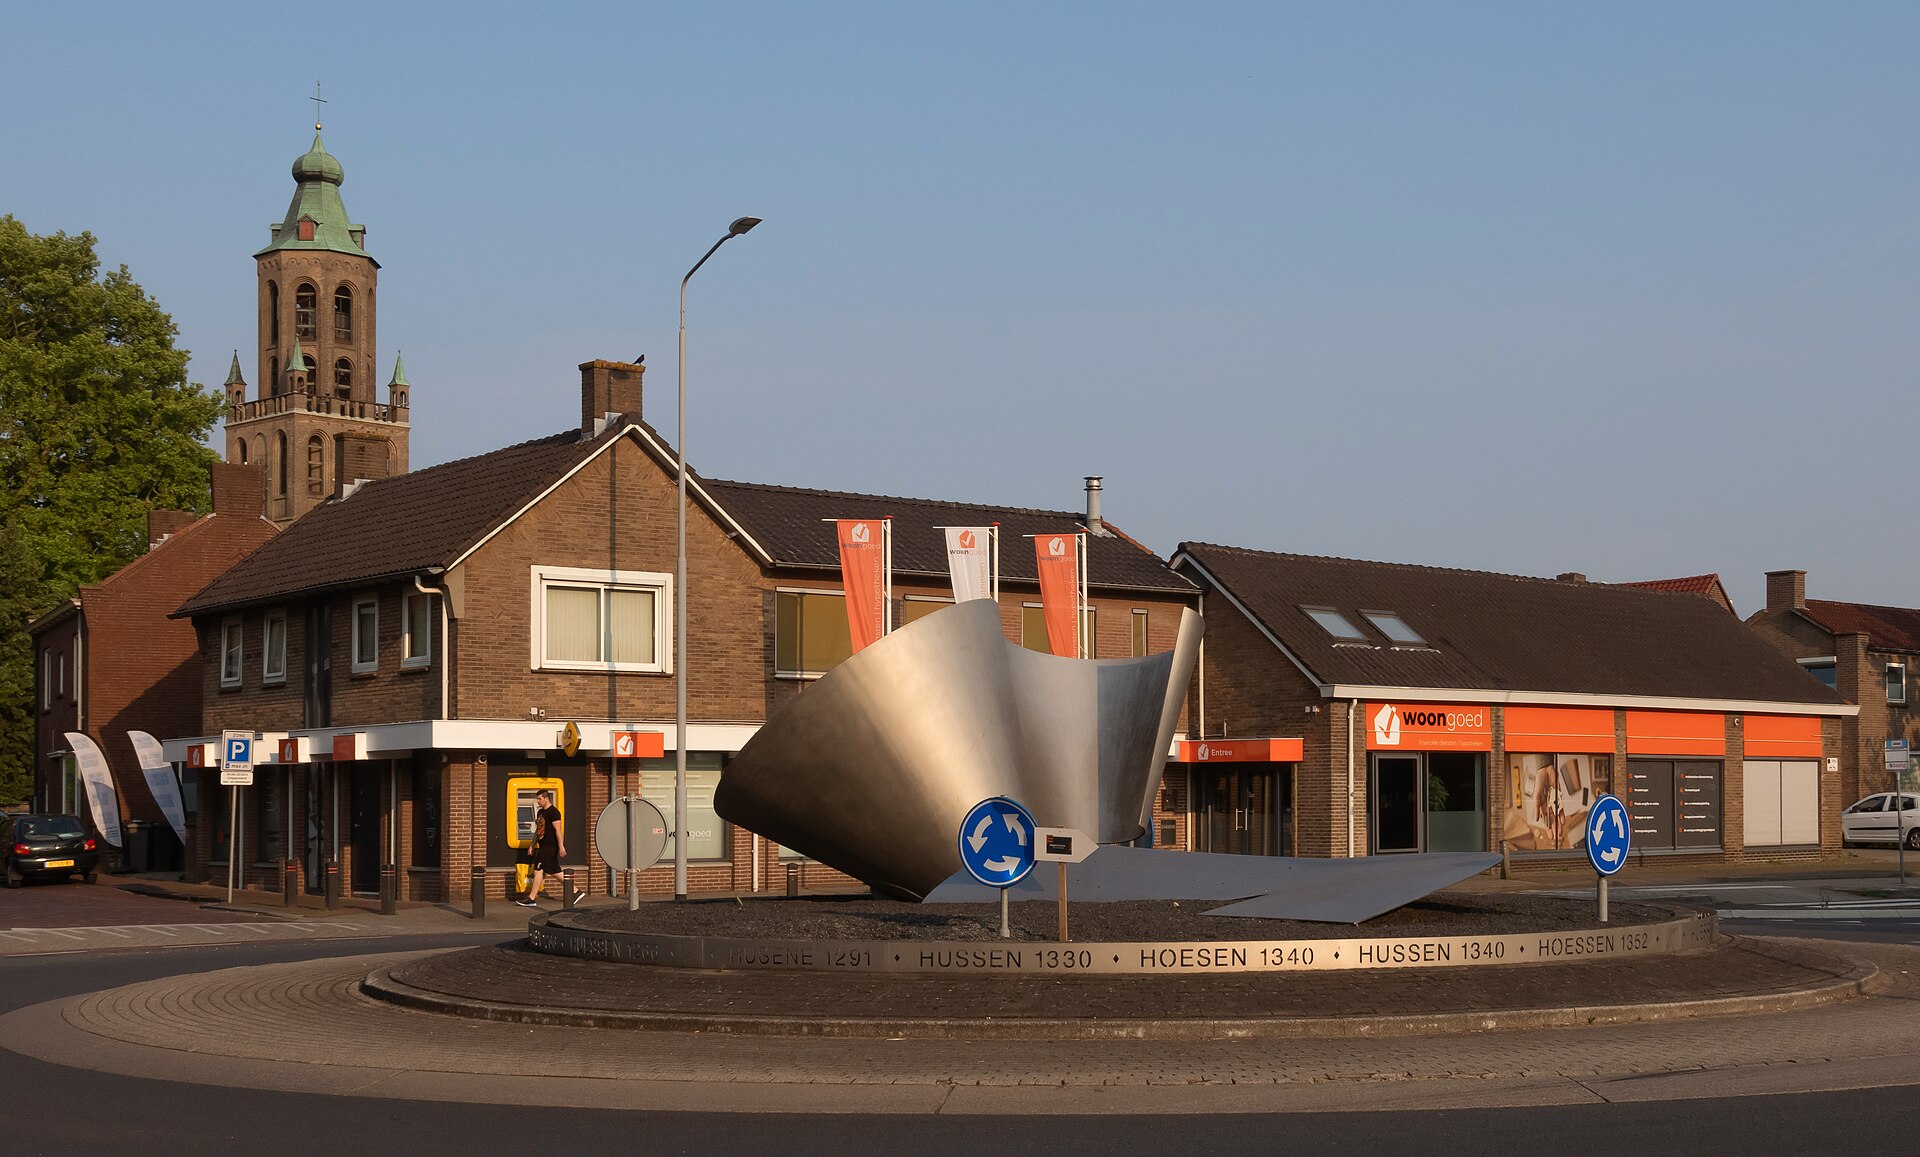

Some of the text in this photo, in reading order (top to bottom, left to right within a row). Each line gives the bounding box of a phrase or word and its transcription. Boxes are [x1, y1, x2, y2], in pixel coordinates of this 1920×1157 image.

[1402, 709, 1483, 731] woongoed
[231, 741, 246, 760] P
[1211, 749, 1233, 757] Entree
[920, 949, 1022, 968] HUSSEN
[1035, 950, 1092, 968] 1330
[1140, 948, 1247, 968] HOESEN
[1260, 947, 1314, 966] 1340
[1359, 943, 1451, 963] HUSSEN
[1461, 941, 1505, 960] 1340
[1538, 935, 1615, 957] HOESSEN
[1621, 932, 1648, 950] 1352
